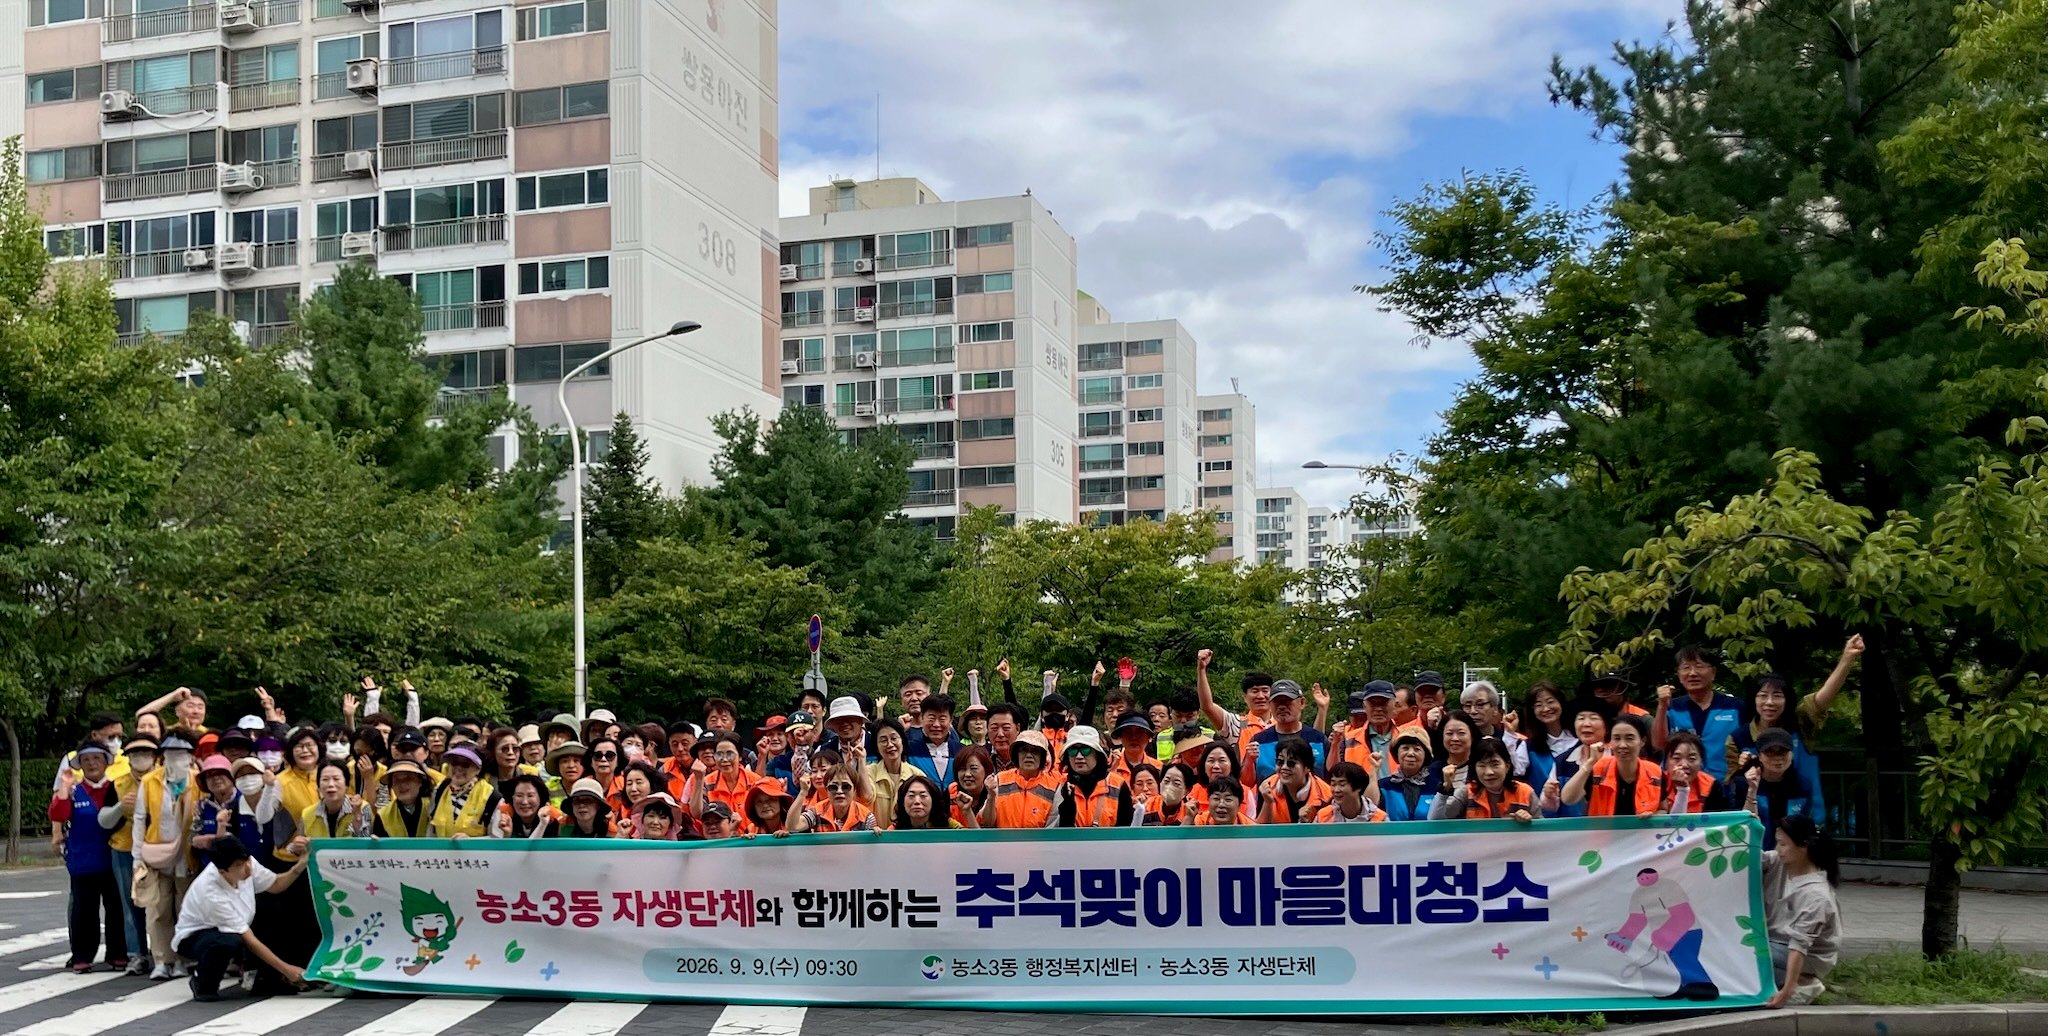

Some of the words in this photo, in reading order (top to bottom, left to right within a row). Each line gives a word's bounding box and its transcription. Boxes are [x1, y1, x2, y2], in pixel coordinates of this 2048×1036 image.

[681, 46, 749, 133] 쌍용아진
[697, 220, 738, 278] 308
[1045, 341, 1070, 381] 쌍용아진
[1051, 439, 1066, 468] 305
[476, 888, 603, 928] 농소3동
[612, 888, 784, 928] 자생단체와
[791, 887, 941, 929] 함께하는
[955, 867, 1203, 929] 추석맞이
[1217, 861, 1550, 927] 마을대청소
[676, 957, 723, 975] 2026.
[730, 958, 746, 975] 9.
[753, 956, 799, 978] 9.(수)
[805, 959, 858, 976] 09:30
[951, 957, 1019, 978] 농소3동
[1025, 957, 1138, 978] 행정복지센터
[1159, 957, 1230, 977] 농소3동
[1237, 956, 1316, 977] 자생단체
